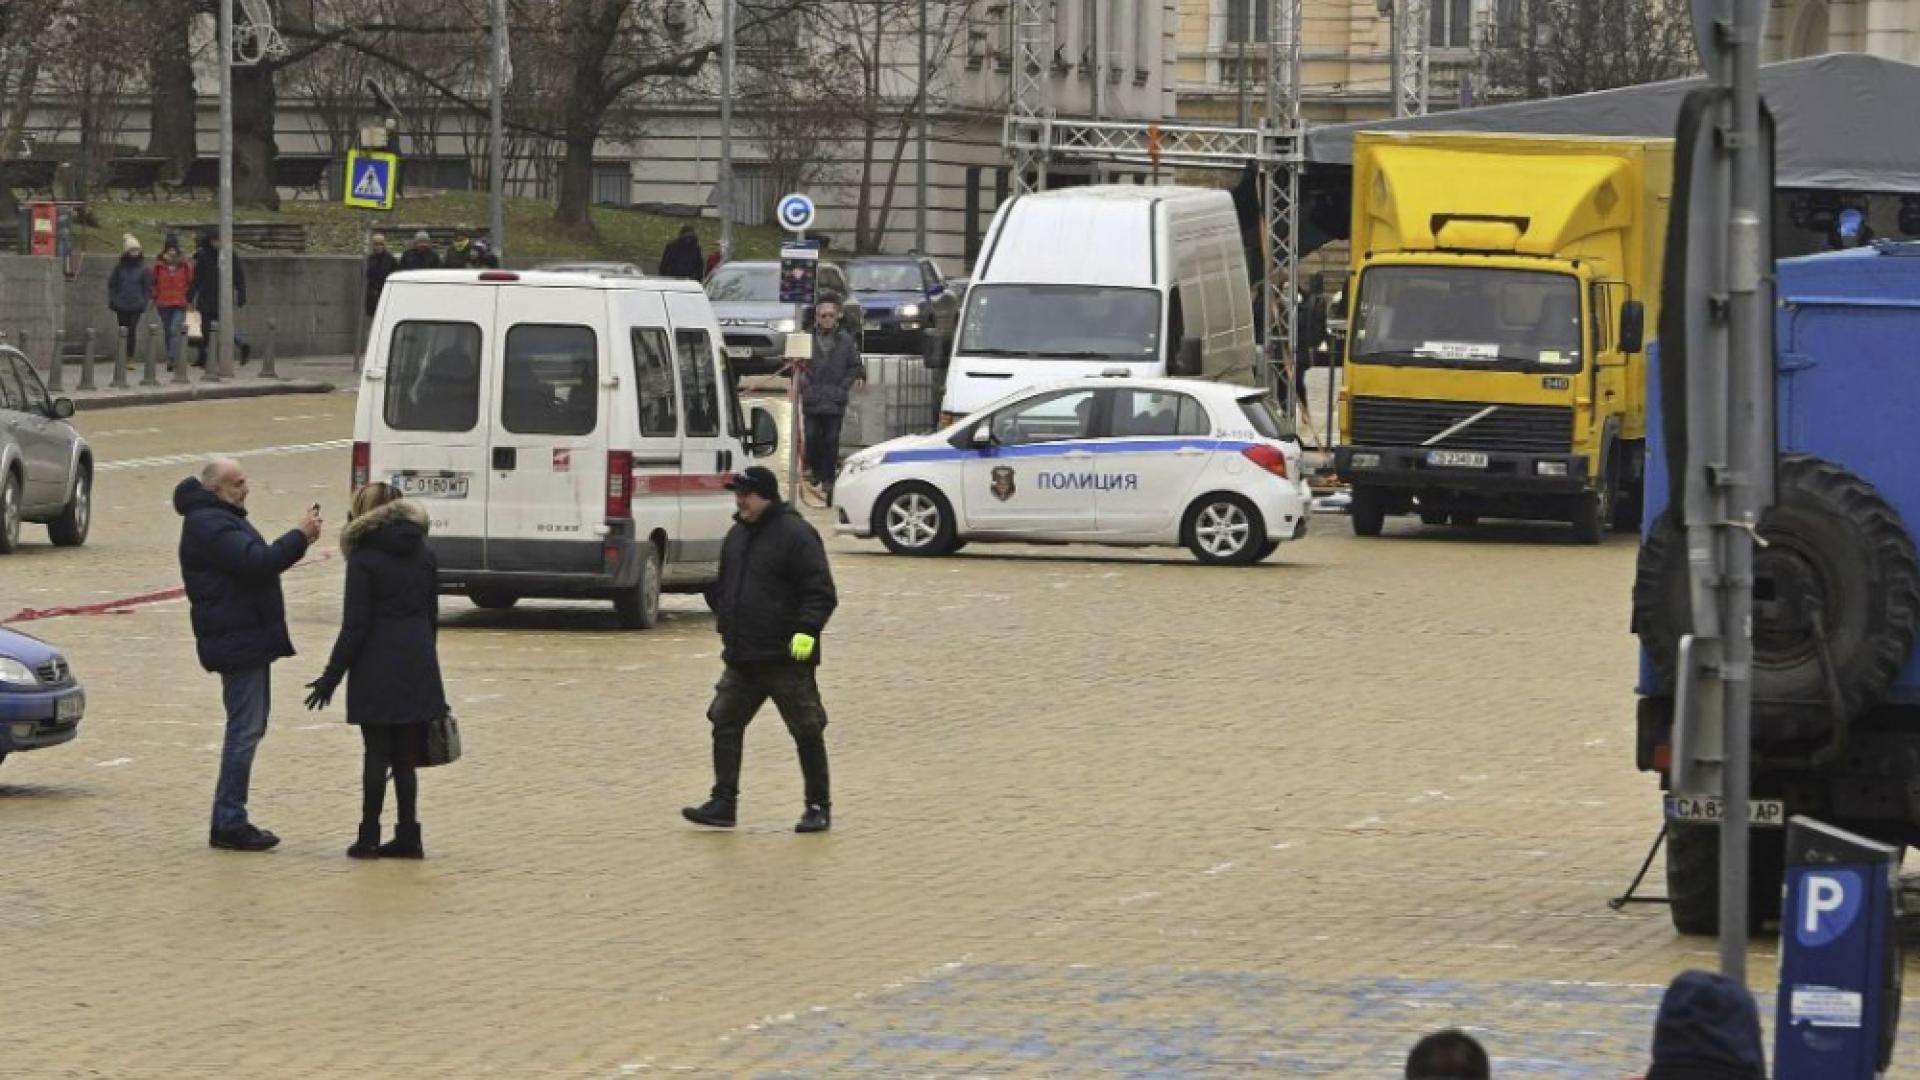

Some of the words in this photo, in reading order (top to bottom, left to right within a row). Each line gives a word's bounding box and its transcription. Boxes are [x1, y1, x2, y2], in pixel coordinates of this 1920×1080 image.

[1037, 471, 1139, 491] ПОЛИЦИЯ
[1677, 799, 1701, 818] CA
[1756, 802, 1779, 819] AP
[1805, 876, 1844, 933] P
